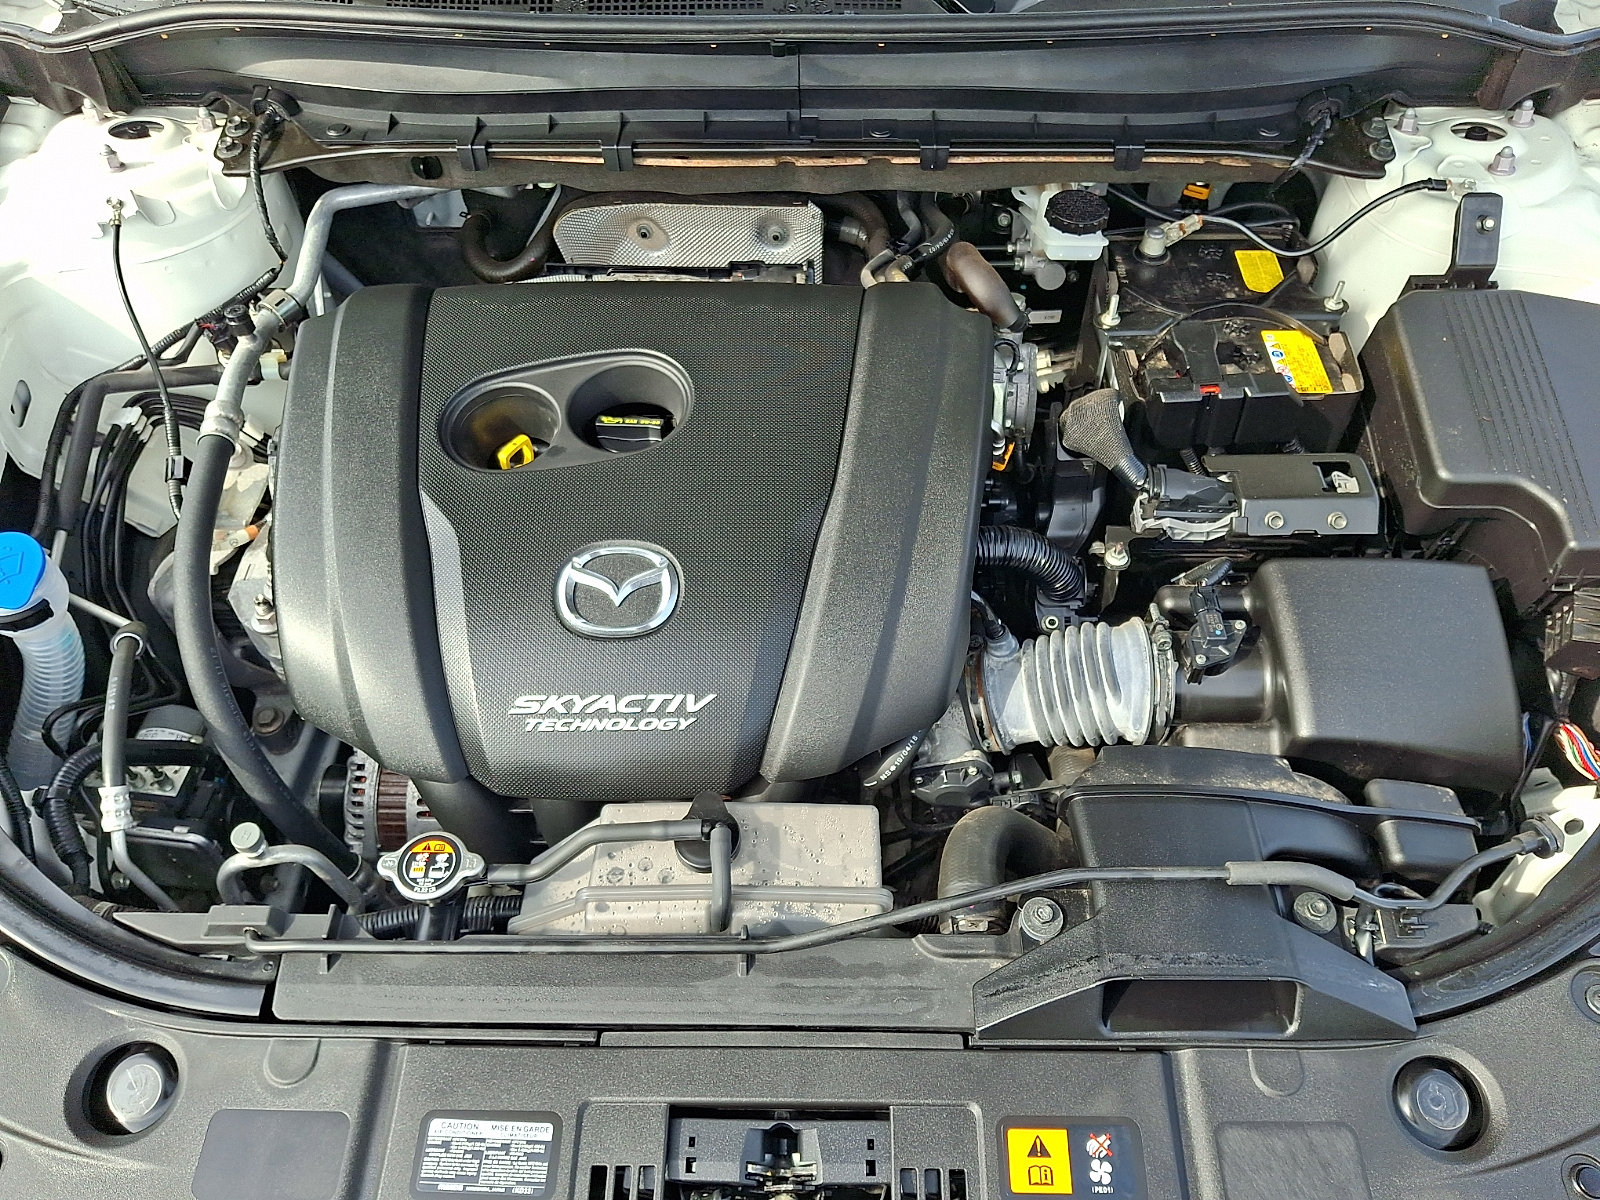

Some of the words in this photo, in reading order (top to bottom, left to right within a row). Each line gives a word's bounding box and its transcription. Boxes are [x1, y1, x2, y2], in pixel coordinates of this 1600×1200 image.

[508, 693, 718, 715] SKYACTIV
[525, 717, 698, 732] TECHNOLOGY
[441, 1121, 480, 1130] CAUTION
[523, 1125, 550, 1134] GARDE
